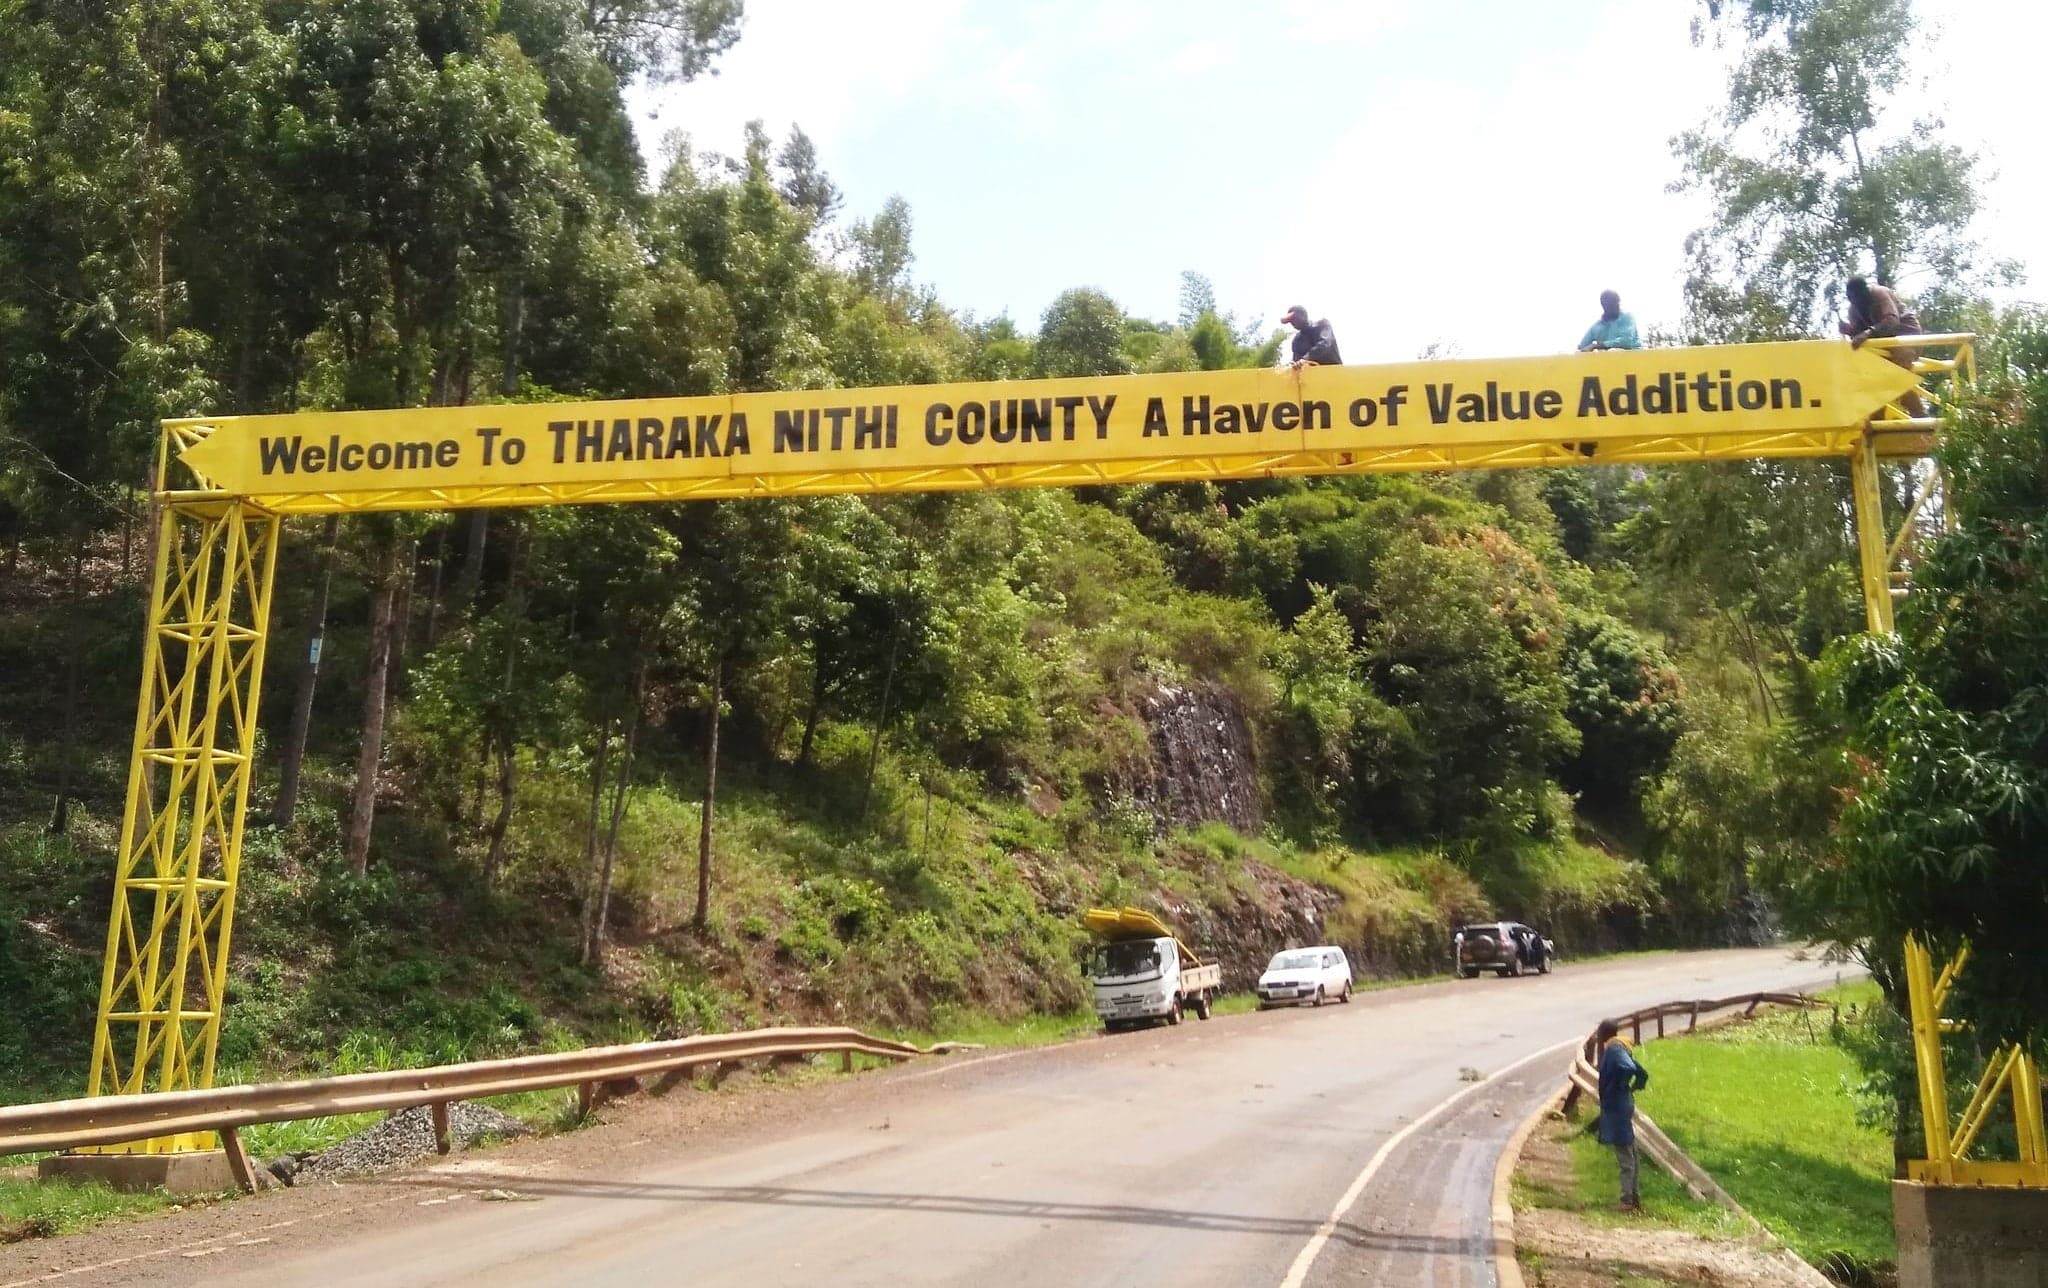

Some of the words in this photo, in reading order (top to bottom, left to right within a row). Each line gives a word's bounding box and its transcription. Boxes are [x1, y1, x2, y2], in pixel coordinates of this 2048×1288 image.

[259, 434, 460, 476] Welcome
[476, 428, 526, 467] To
[547, 412, 751, 464] THARAKA
[773, 405, 898, 454] NITHI
[925, 394, 1117, 447] COUNTY
[1142, 397, 1169, 439] A
[1182, 395, 1331, 436] Haven
[1349, 385, 1409, 429] of
[1425, 381, 1563, 425] Value
[1577, 369, 1823, 418] Addition.
